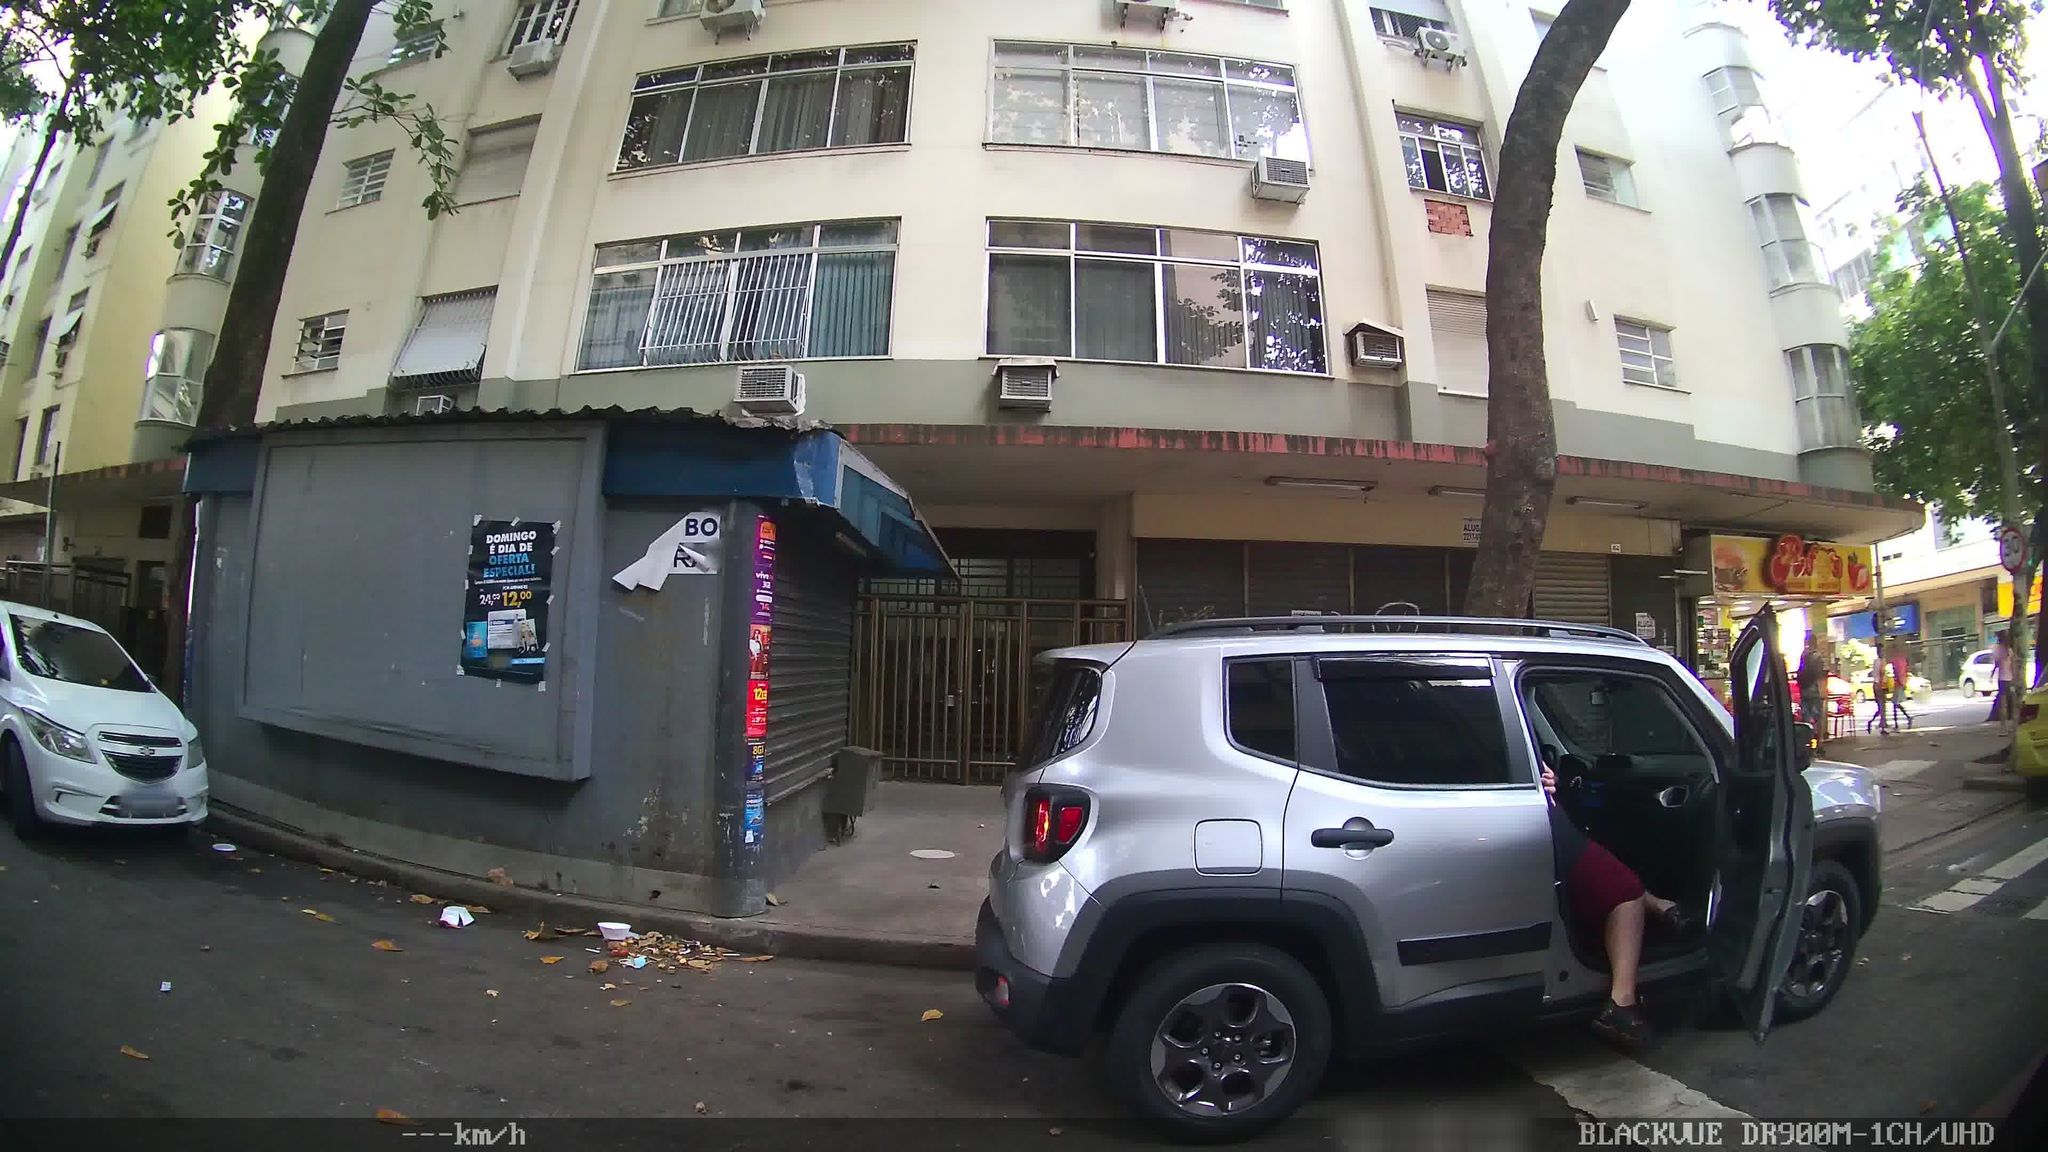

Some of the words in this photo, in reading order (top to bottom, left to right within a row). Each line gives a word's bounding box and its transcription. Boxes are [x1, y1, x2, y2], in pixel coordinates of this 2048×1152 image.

[684, 518, 718, 537] BO
[1463, 523, 1480, 532] ALUG
[486, 531, 537, 544] DOMINGO
[489, 544, 495, 555] É
[498, 544, 516, 554] DIA
[519, 542, 533, 552] DE
[488, 553, 529, 565] OFERTA
[483, 563, 536, 578] ESPECIAL!
